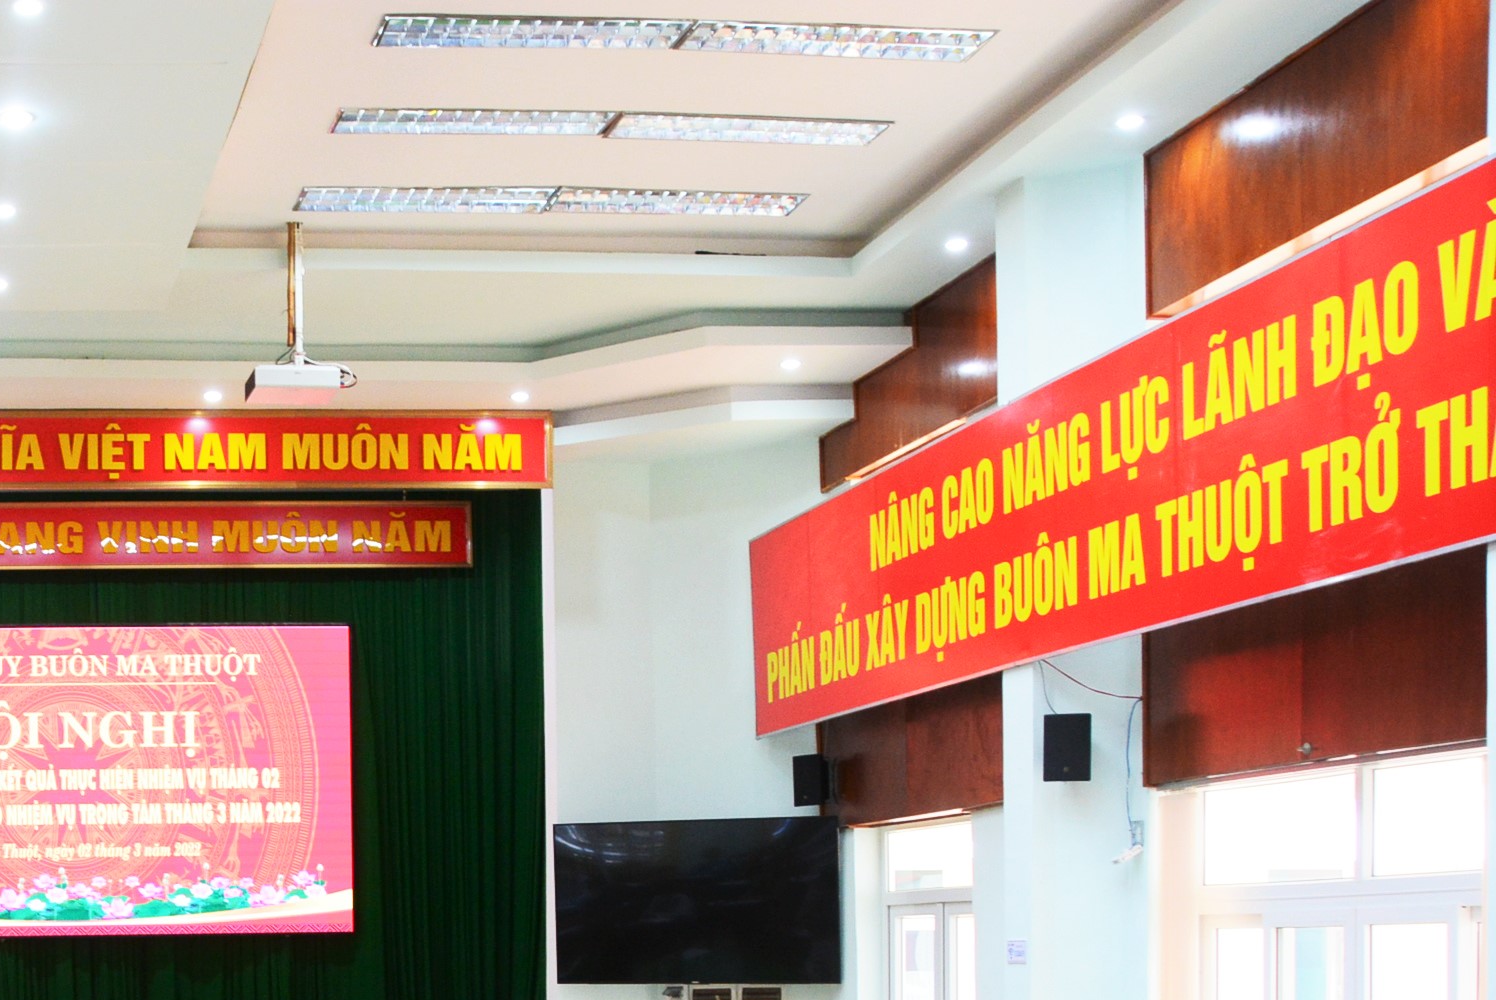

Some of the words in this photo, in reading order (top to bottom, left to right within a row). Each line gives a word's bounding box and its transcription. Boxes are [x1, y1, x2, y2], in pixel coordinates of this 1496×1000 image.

[870, 487, 934, 571] NÂNG
[942, 458, 994, 538] CAO
[1003, 413, 1090, 514] NĂNG
[1101, 376, 1169, 480] LỰC
[1183, 315, 1296, 440] LÃNH
[1311, 261, 1418, 390] ĐẠO
[58, 423, 150, 479] VIỆT
[164, 433, 267, 470] NAM
[282, 423, 409, 470] MUÔN
[423, 424, 523, 471] NĂM
[98, 521, 198, 553] VINH
[213, 512, 338, 553] MUÔN
[353, 512, 451, 552] NĂM
[768, 621, 814, 703] PHẤN
[820, 602, 860, 684] ĐẤU
[866, 594, 908, 670] XÂY
[916, 572, 985, 661] DỰNG
[995, 532, 1078, 628] BUÔN
[1089, 514, 1146, 599] MA
[1156, 454, 1288, 576] THUỘT
[1302, 392, 1400, 532] TRỞ
[1417, 387, 1496, 496] TH
[29, 648, 107, 677] BUÔN
[116, 655, 159, 676] MA
[165, 647, 261, 682] THUỘT
[58, 710, 200, 758] NGHỊ
